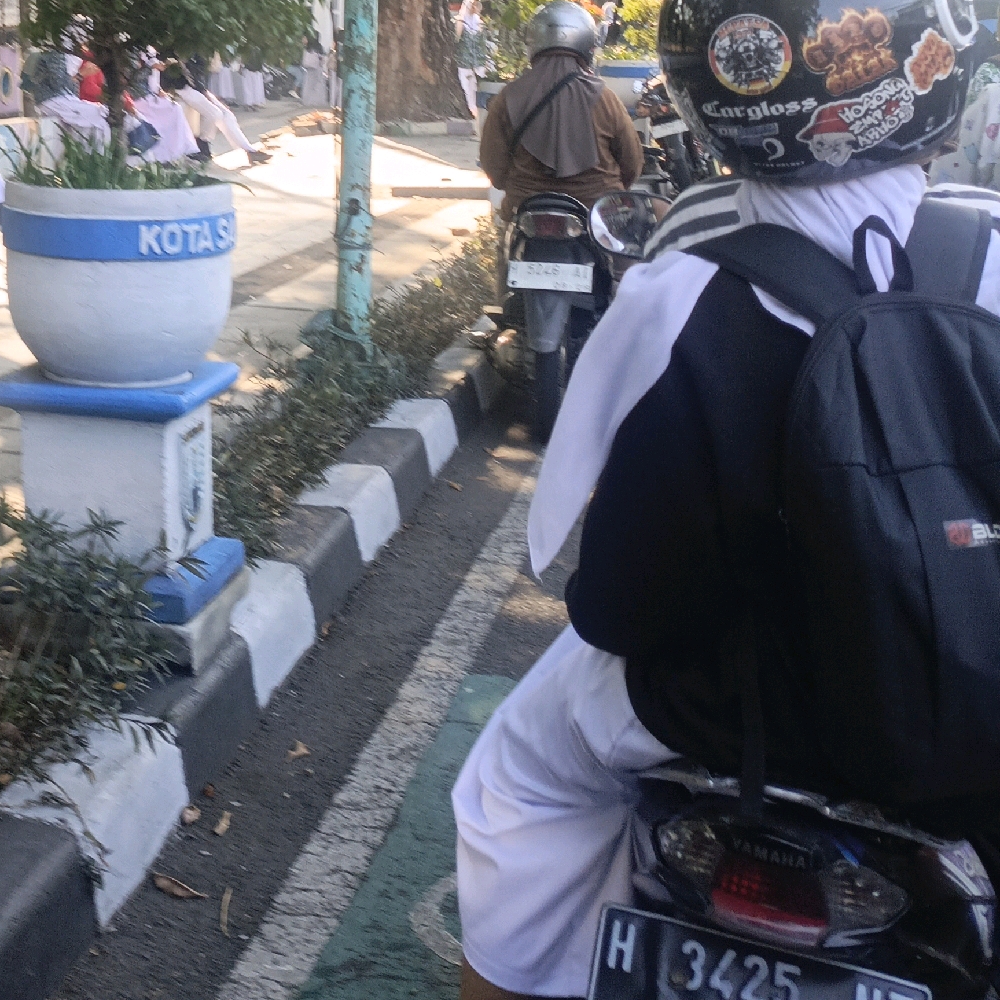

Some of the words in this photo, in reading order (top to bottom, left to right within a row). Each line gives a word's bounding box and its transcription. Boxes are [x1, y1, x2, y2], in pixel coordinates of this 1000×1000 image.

[702, 97, 818, 121] Cargloss
[138, 222, 215, 256] KOTA
[731, 838, 806, 868] YAMAHA
[607, 919, 636, 973] H
[681, 939, 801, 1000] 3425
